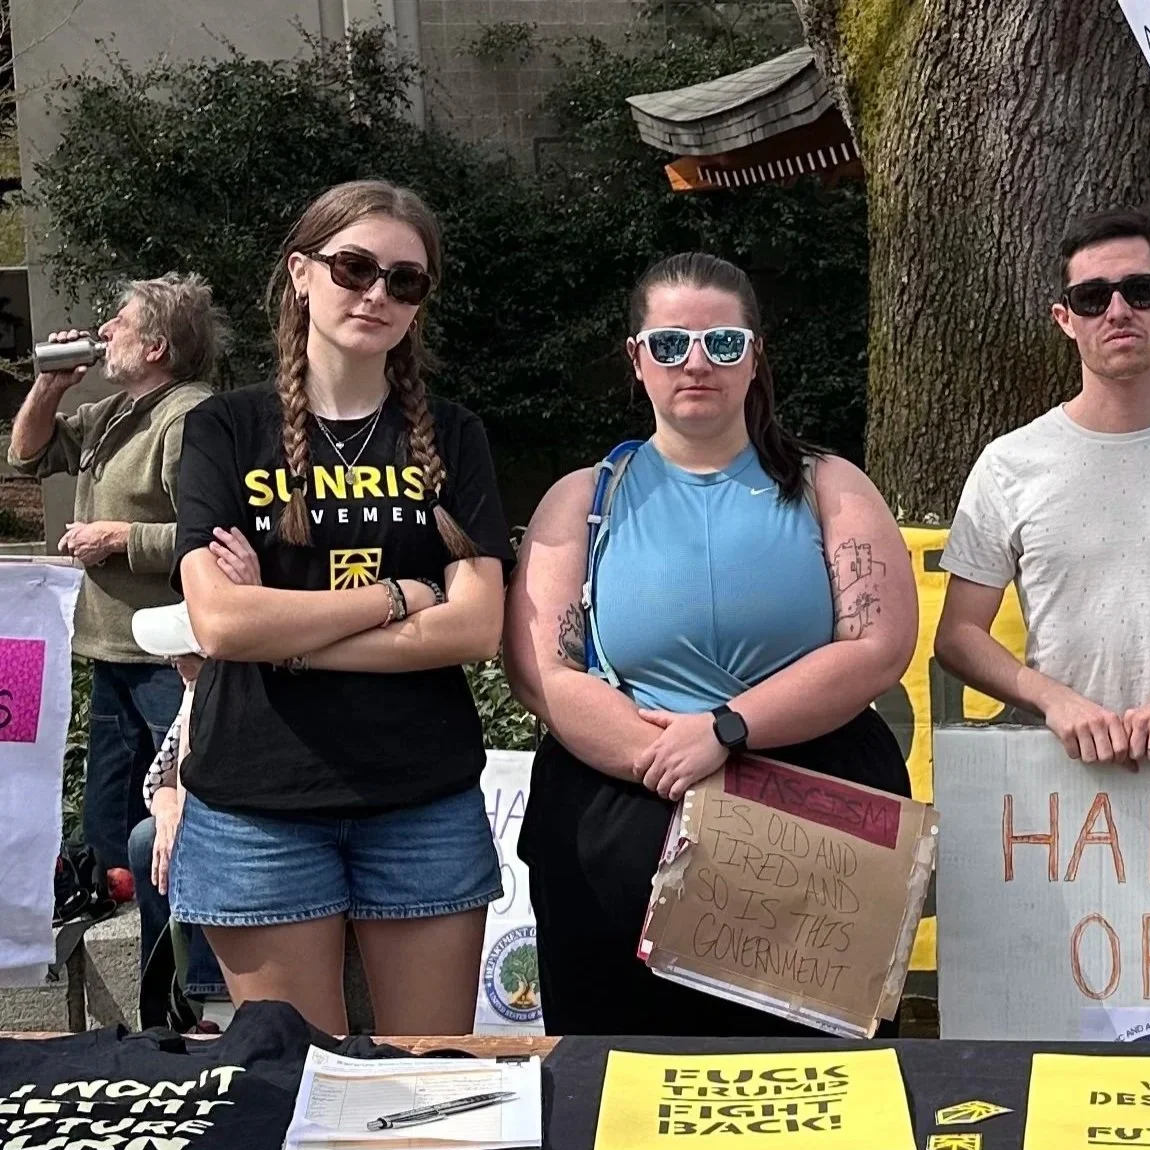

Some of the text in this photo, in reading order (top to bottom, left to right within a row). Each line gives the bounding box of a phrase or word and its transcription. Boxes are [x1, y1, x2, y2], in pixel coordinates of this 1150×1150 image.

[244, 465, 434, 507] SUNRIS
[255, 507, 428, 531] MVEMEN
[732, 760, 890, 837] FASCISM
[711, 799, 857, 878] IS OLD AND
[706, 828, 860, 914] TIRED AND
[696, 867, 855, 952] SO IS THIS
[692, 912, 850, 992] GOVERNMENT
[1126, 1025, 1144, 1038] AND
[9, 1066, 246, 1098] I WON'T
[663, 1065, 849, 1084] FUCK
[661, 1080, 850, 1097] TRUMP
[130, 1098, 235, 1115] MY
[658, 1098, 843, 1119] FIGHT
[0, 1117, 215, 1135] UTURE
[658, 1114, 843, 1136] BACK!
